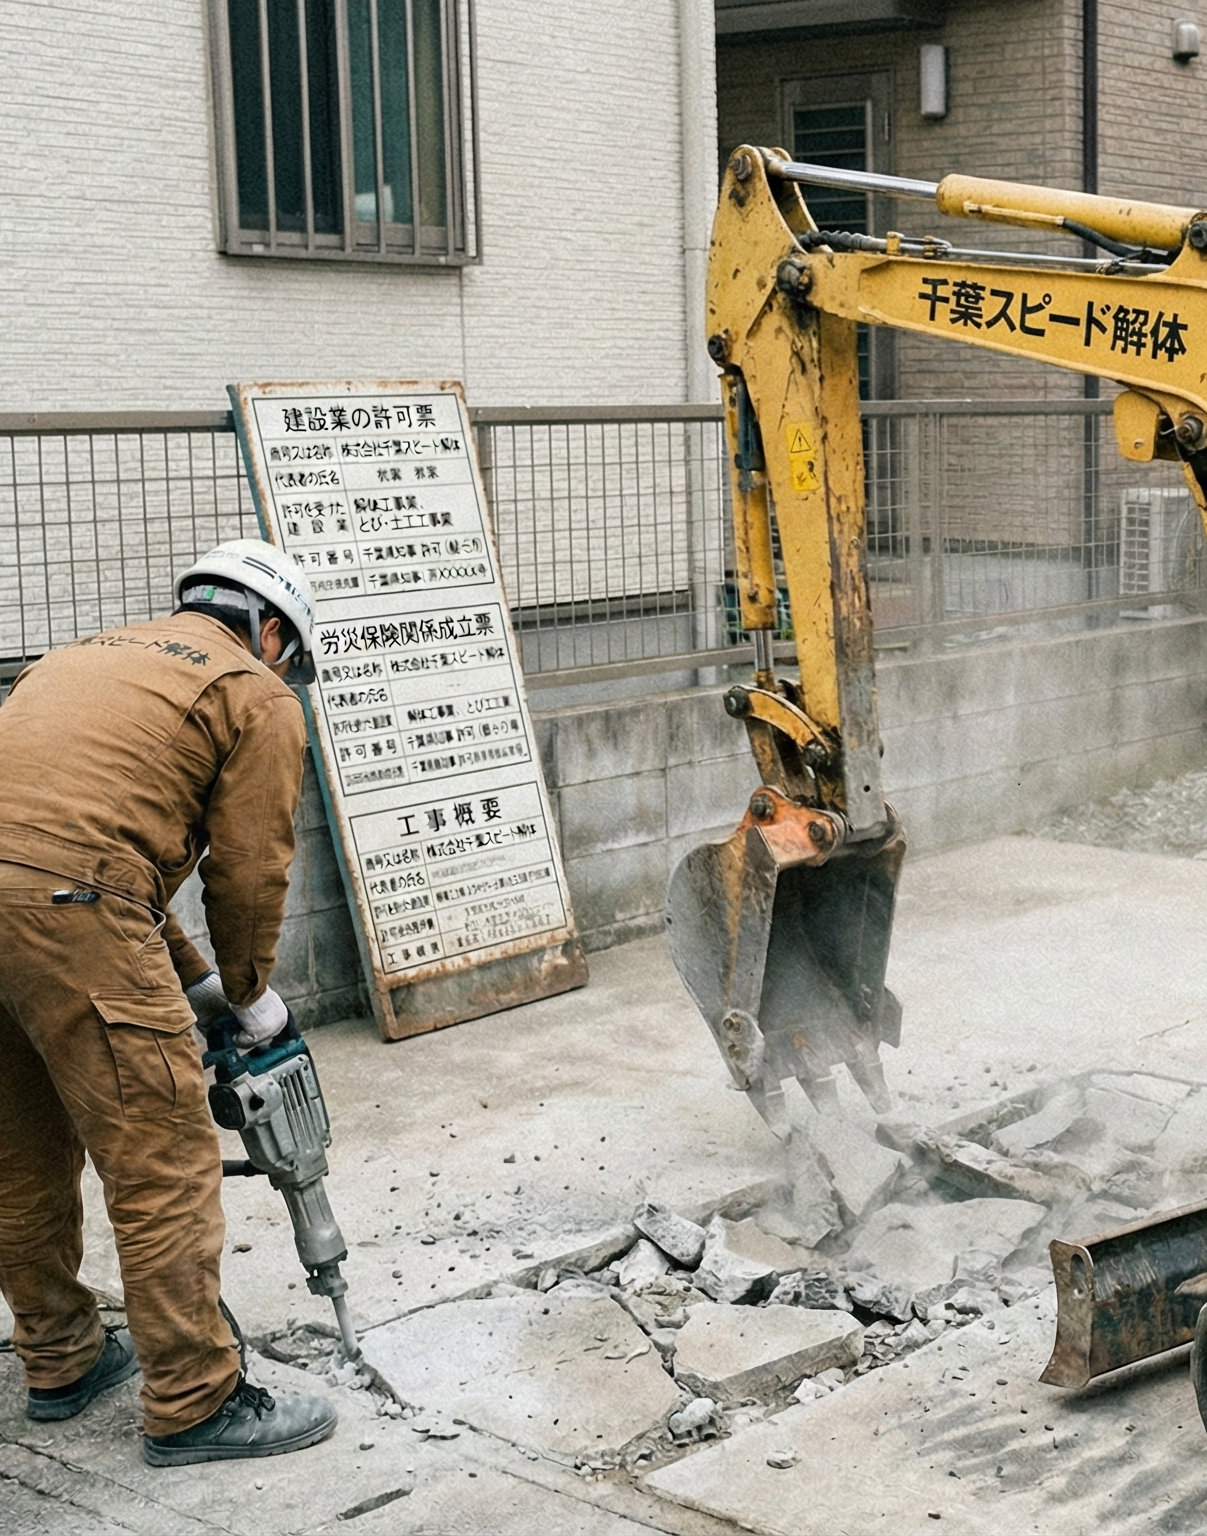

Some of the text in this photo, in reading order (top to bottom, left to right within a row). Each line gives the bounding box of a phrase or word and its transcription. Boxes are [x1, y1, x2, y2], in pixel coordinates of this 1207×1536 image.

[918, 277, 1188, 362] 千葉スピード解体
[282, 403, 436, 432] 建設業の許可票
[320, 612, 494, 655] 労災保険関係成立票
